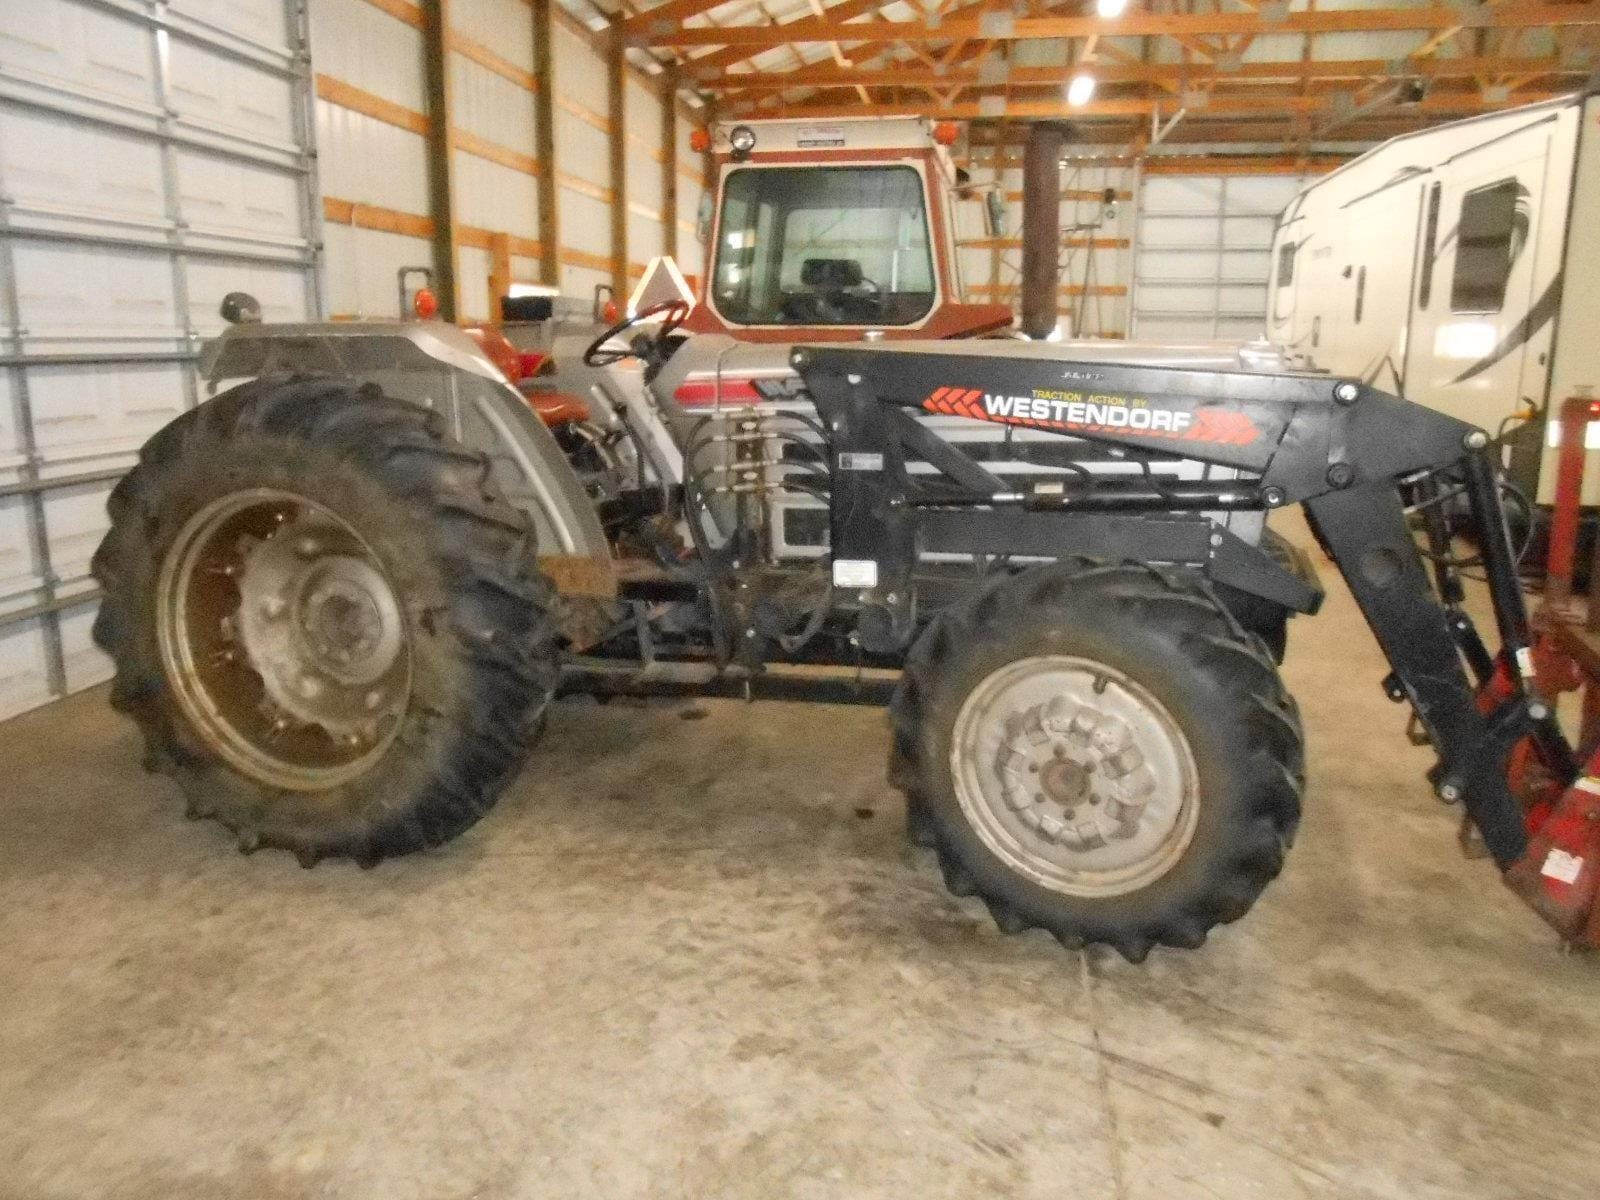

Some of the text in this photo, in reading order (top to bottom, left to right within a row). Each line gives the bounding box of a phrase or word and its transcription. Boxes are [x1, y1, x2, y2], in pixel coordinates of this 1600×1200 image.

[985, 394, 1192, 432] WESTENDORF
[1032, 390, 1147, 408] TRACTION ACTION BY
